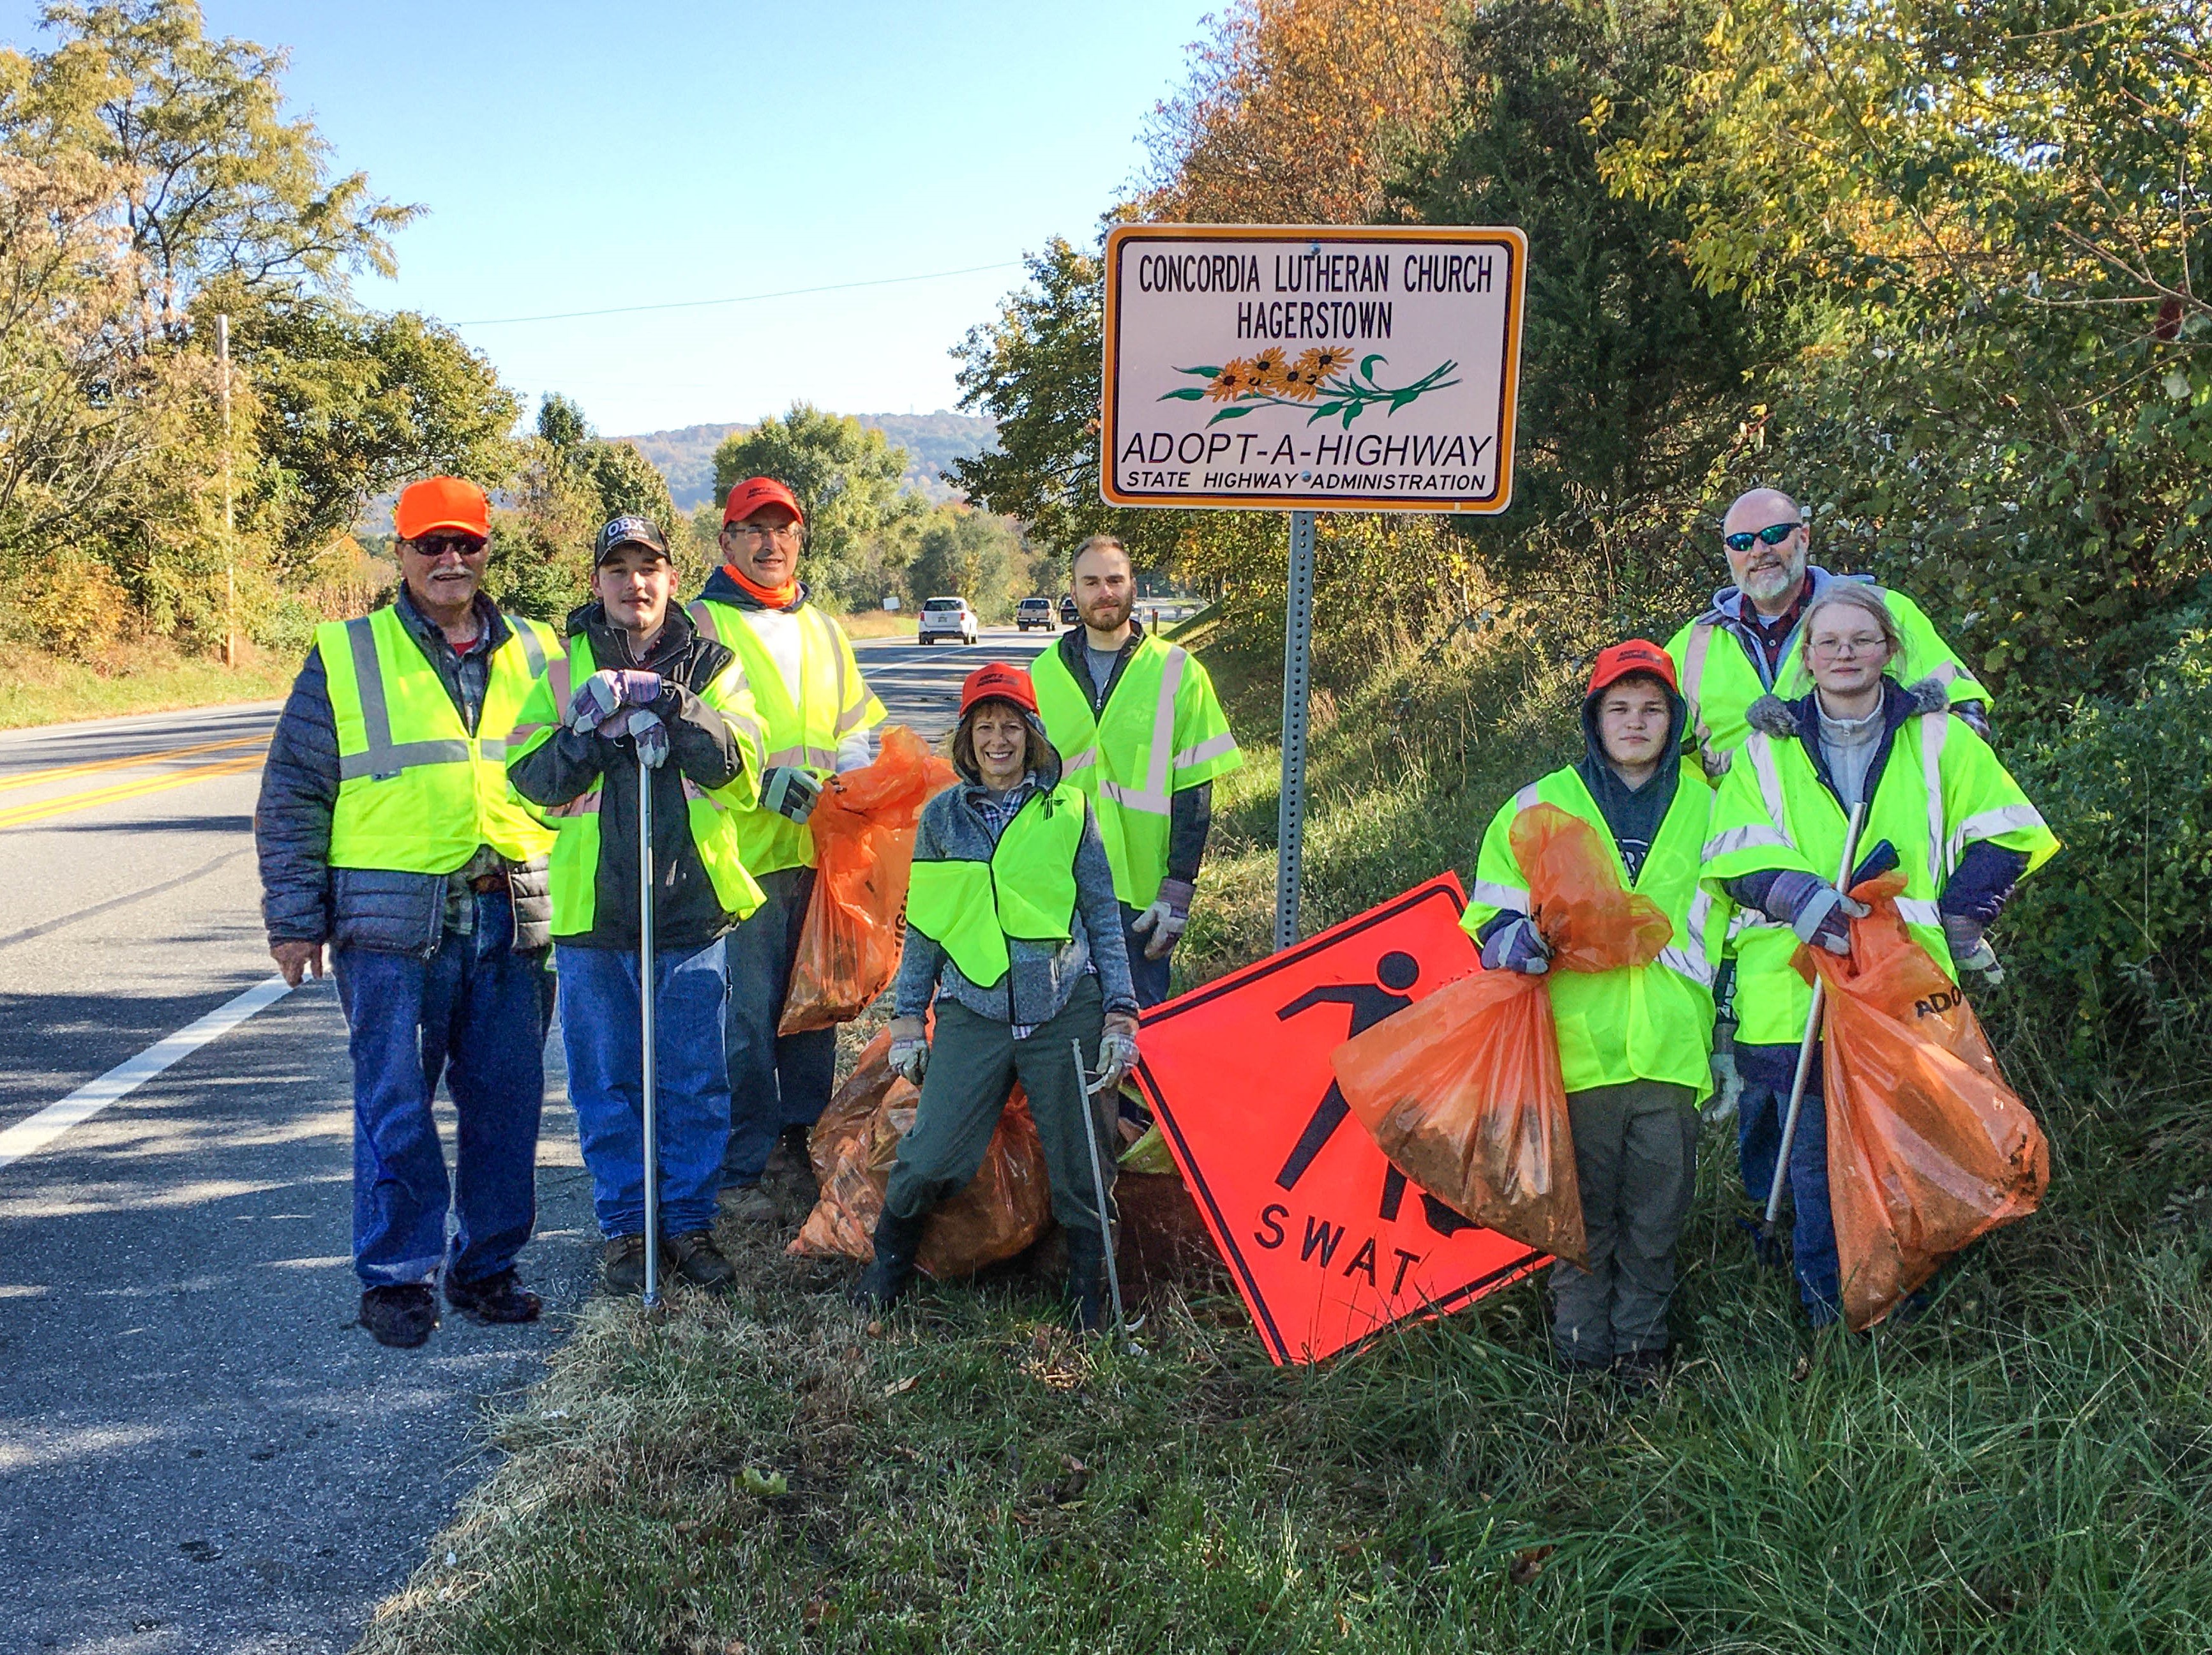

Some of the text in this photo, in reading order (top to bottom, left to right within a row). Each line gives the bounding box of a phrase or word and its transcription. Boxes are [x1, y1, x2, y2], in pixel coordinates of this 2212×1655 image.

[1140, 255, 1492, 293] CONCORDIA LUTHERAN CHURCH
[1237, 301, 1392, 339] HAGERSTOWN
[1122, 432, 1492, 467] ADOPT-A-HIGHWAY
[1127, 471, 1486, 490] STATE HIGHWAY ADMINISTRATION
[608, 518, 646, 536] OBX
[1254, 1204, 1420, 1296] SWAT
